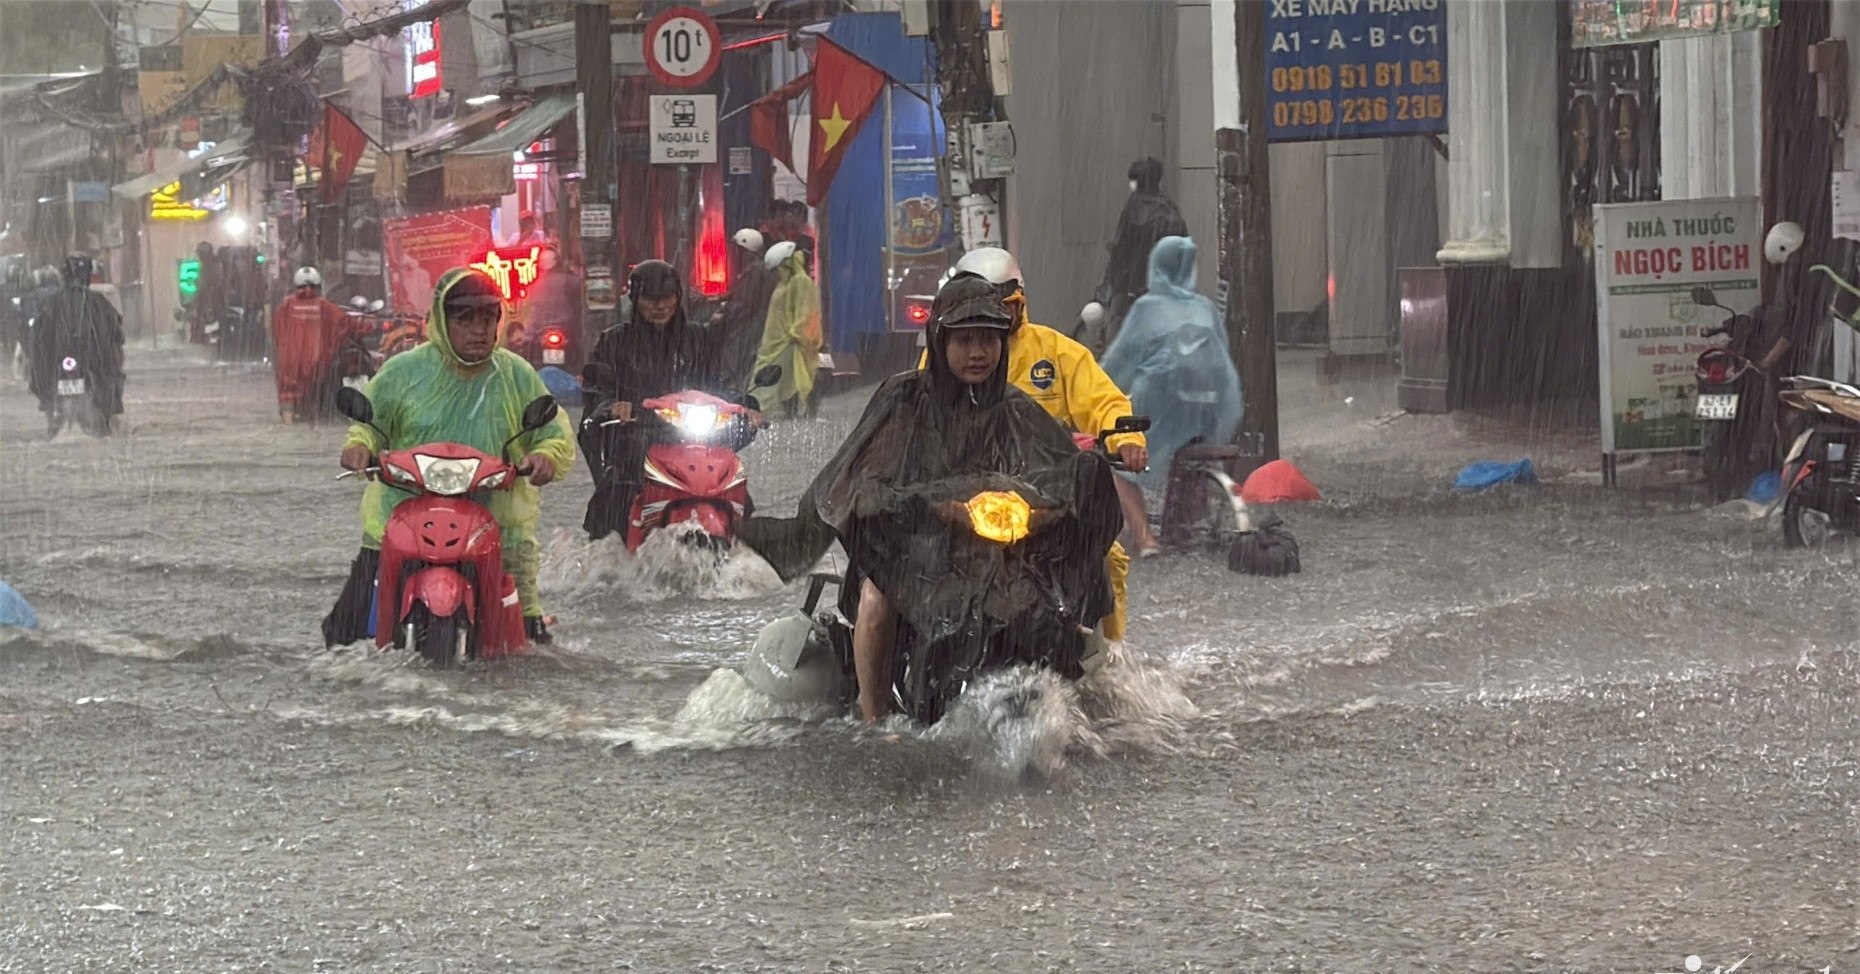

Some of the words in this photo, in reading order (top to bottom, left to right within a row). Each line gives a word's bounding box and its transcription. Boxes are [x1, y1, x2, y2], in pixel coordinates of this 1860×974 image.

[1271, 0, 1302, 17] XE
[1368, 0, 1439, 16] HẠNG
[1271, 32, 1300, 52] A1
[1328, 29, 1346, 49] A
[1369, 27, 1385, 47] B
[1409, 25, 1438, 45] C1
[1339, 63, 1367, 89] 51
[1341, 96, 1388, 124] 236
[1627, 217, 1666, 238] NHÀ
[1672, 211, 1735, 237] THUỐC
[1614, 247, 1682, 279] NGỌC
[1692, 240, 1750, 272] BÍCH
